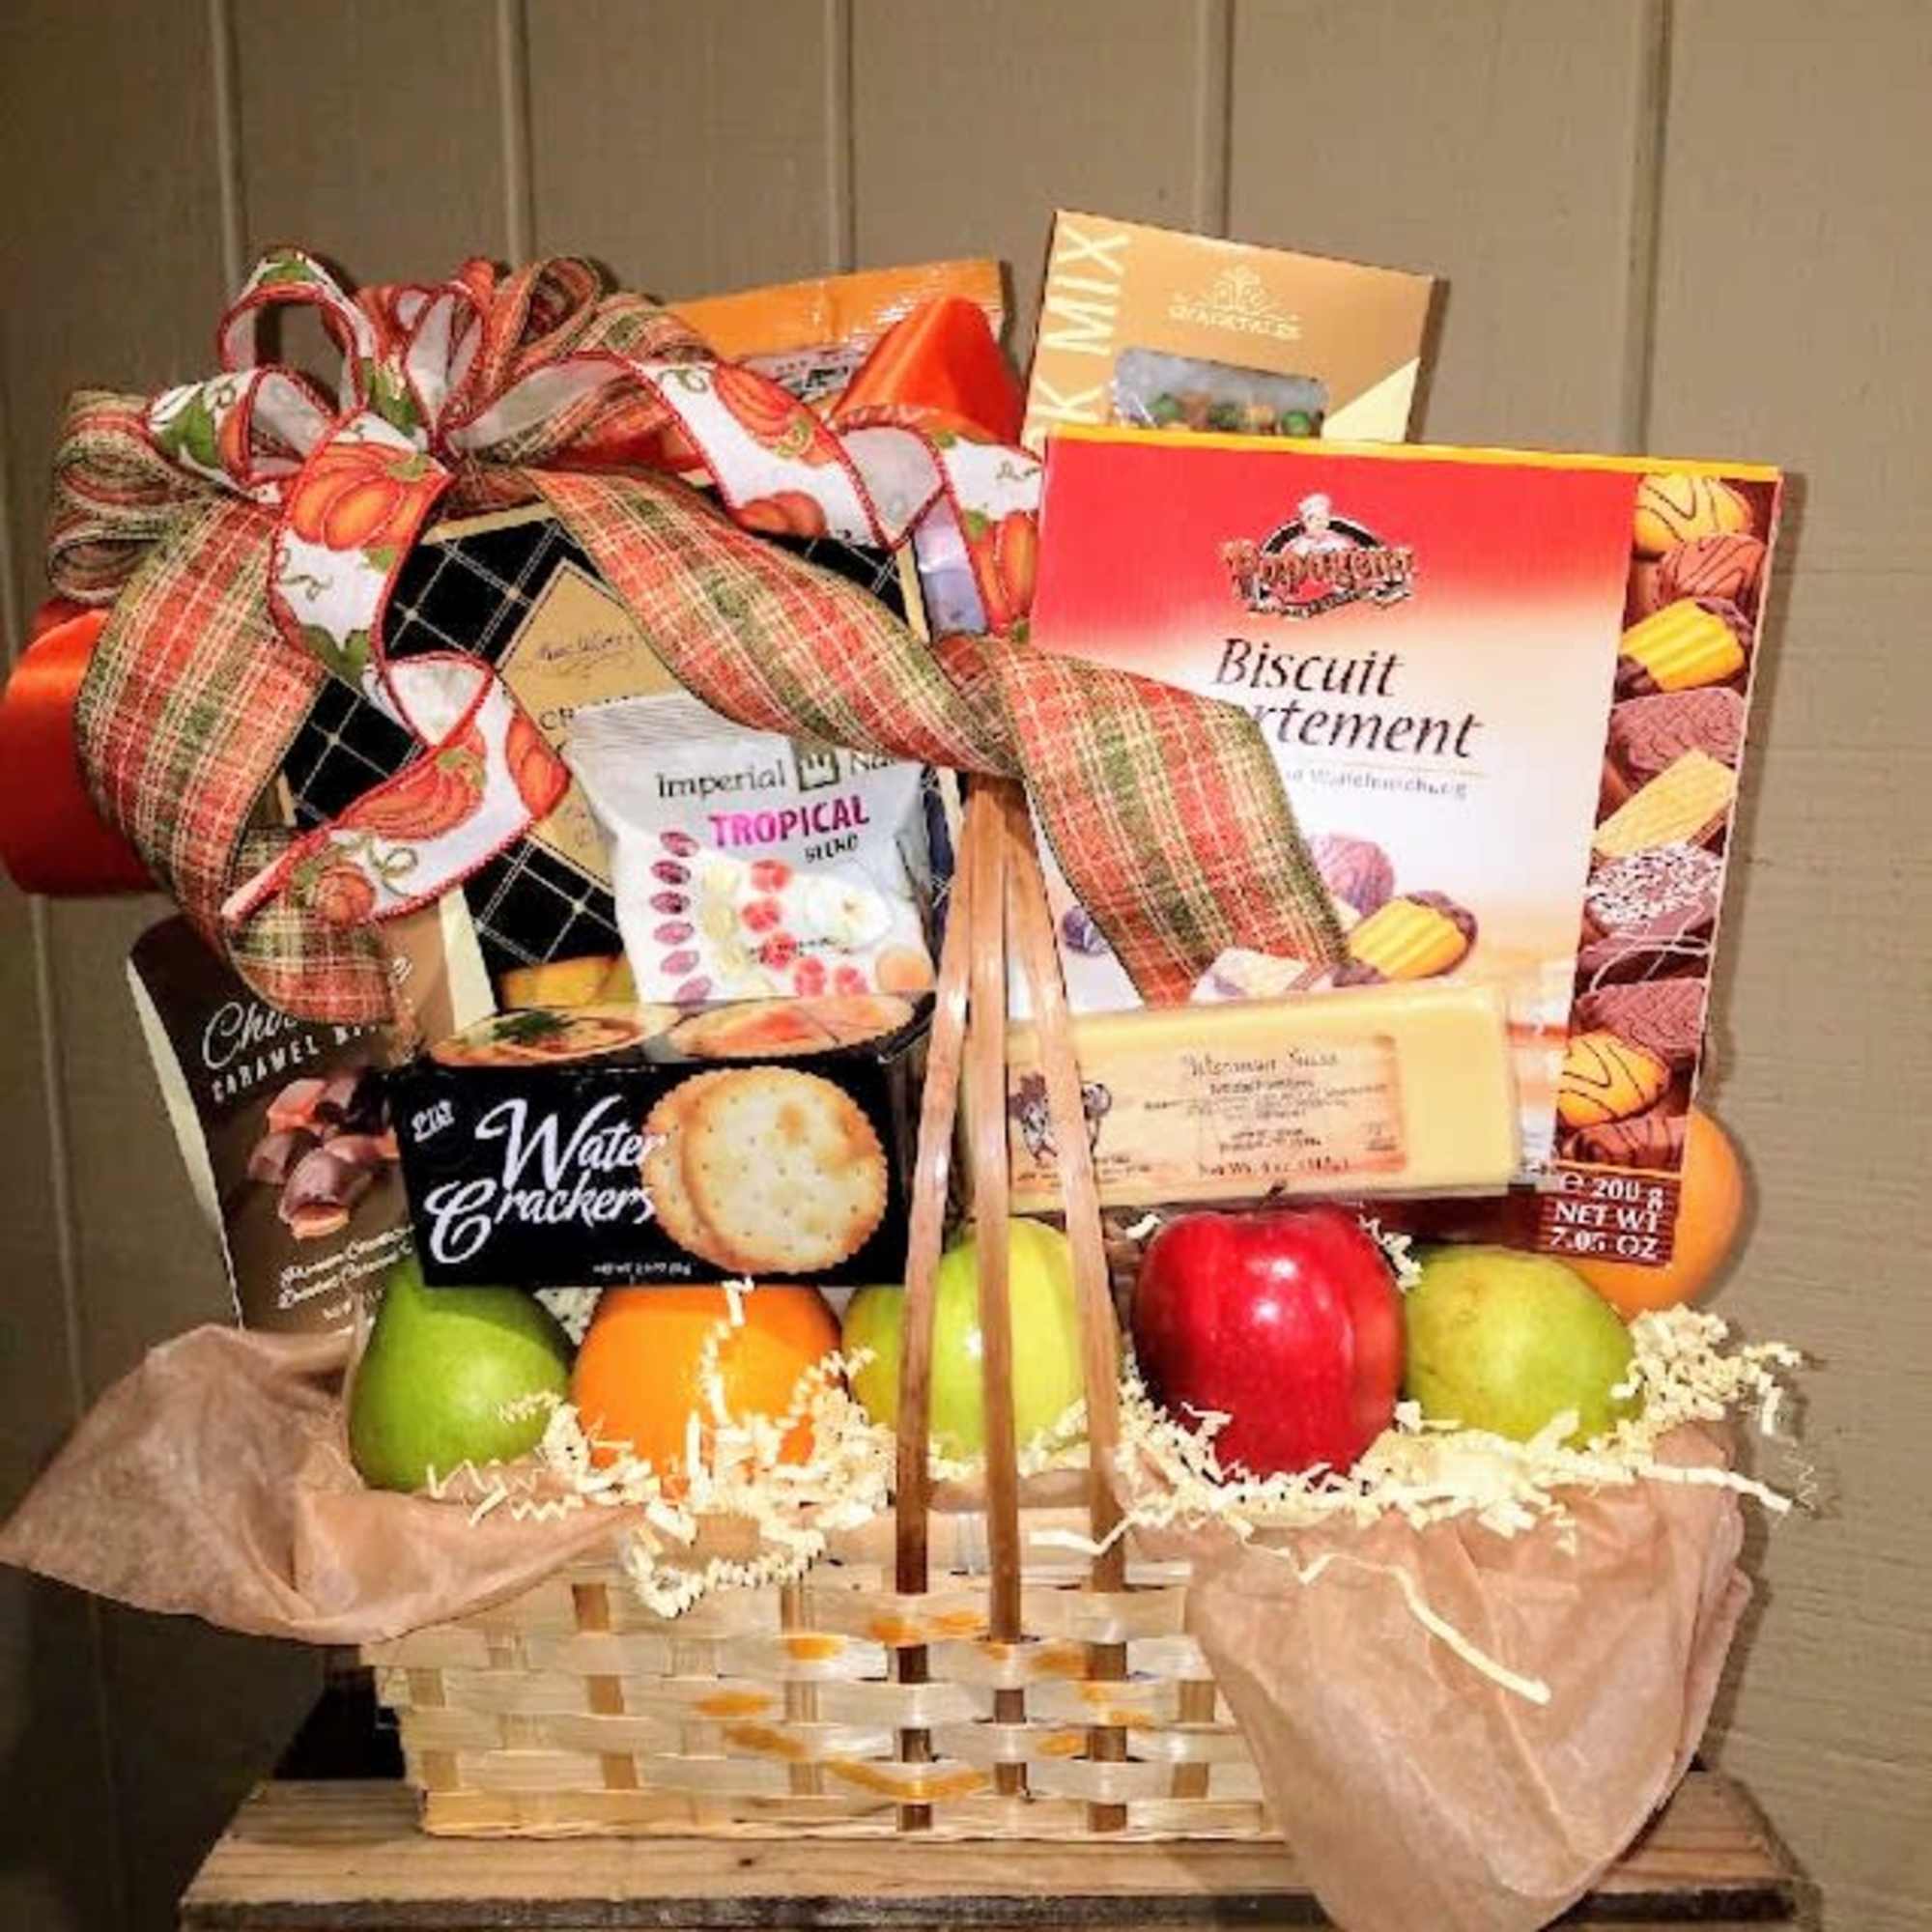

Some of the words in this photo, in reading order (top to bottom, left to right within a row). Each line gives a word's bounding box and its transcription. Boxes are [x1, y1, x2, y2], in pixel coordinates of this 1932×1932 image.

[1043, 223, 1131, 356] MIX
[1214, 638, 1405, 697] Biscuit
[1253, 699, 1485, 758] rtement
[657, 758, 786, 800] Imperial
[708, 794, 871, 848] TROPICAL
[212, 1035, 321, 1103] CARAMEL
[474, 1094, 668, 1192] Water
[425, 1170, 655, 1264] Crackers
[1555, 1202, 1608, 1227] NET
[1616, 1207, 1659, 1234] WT
[1592, 1177, 1640, 1202] 200
[1616, 1235, 1661, 1261] OZ
